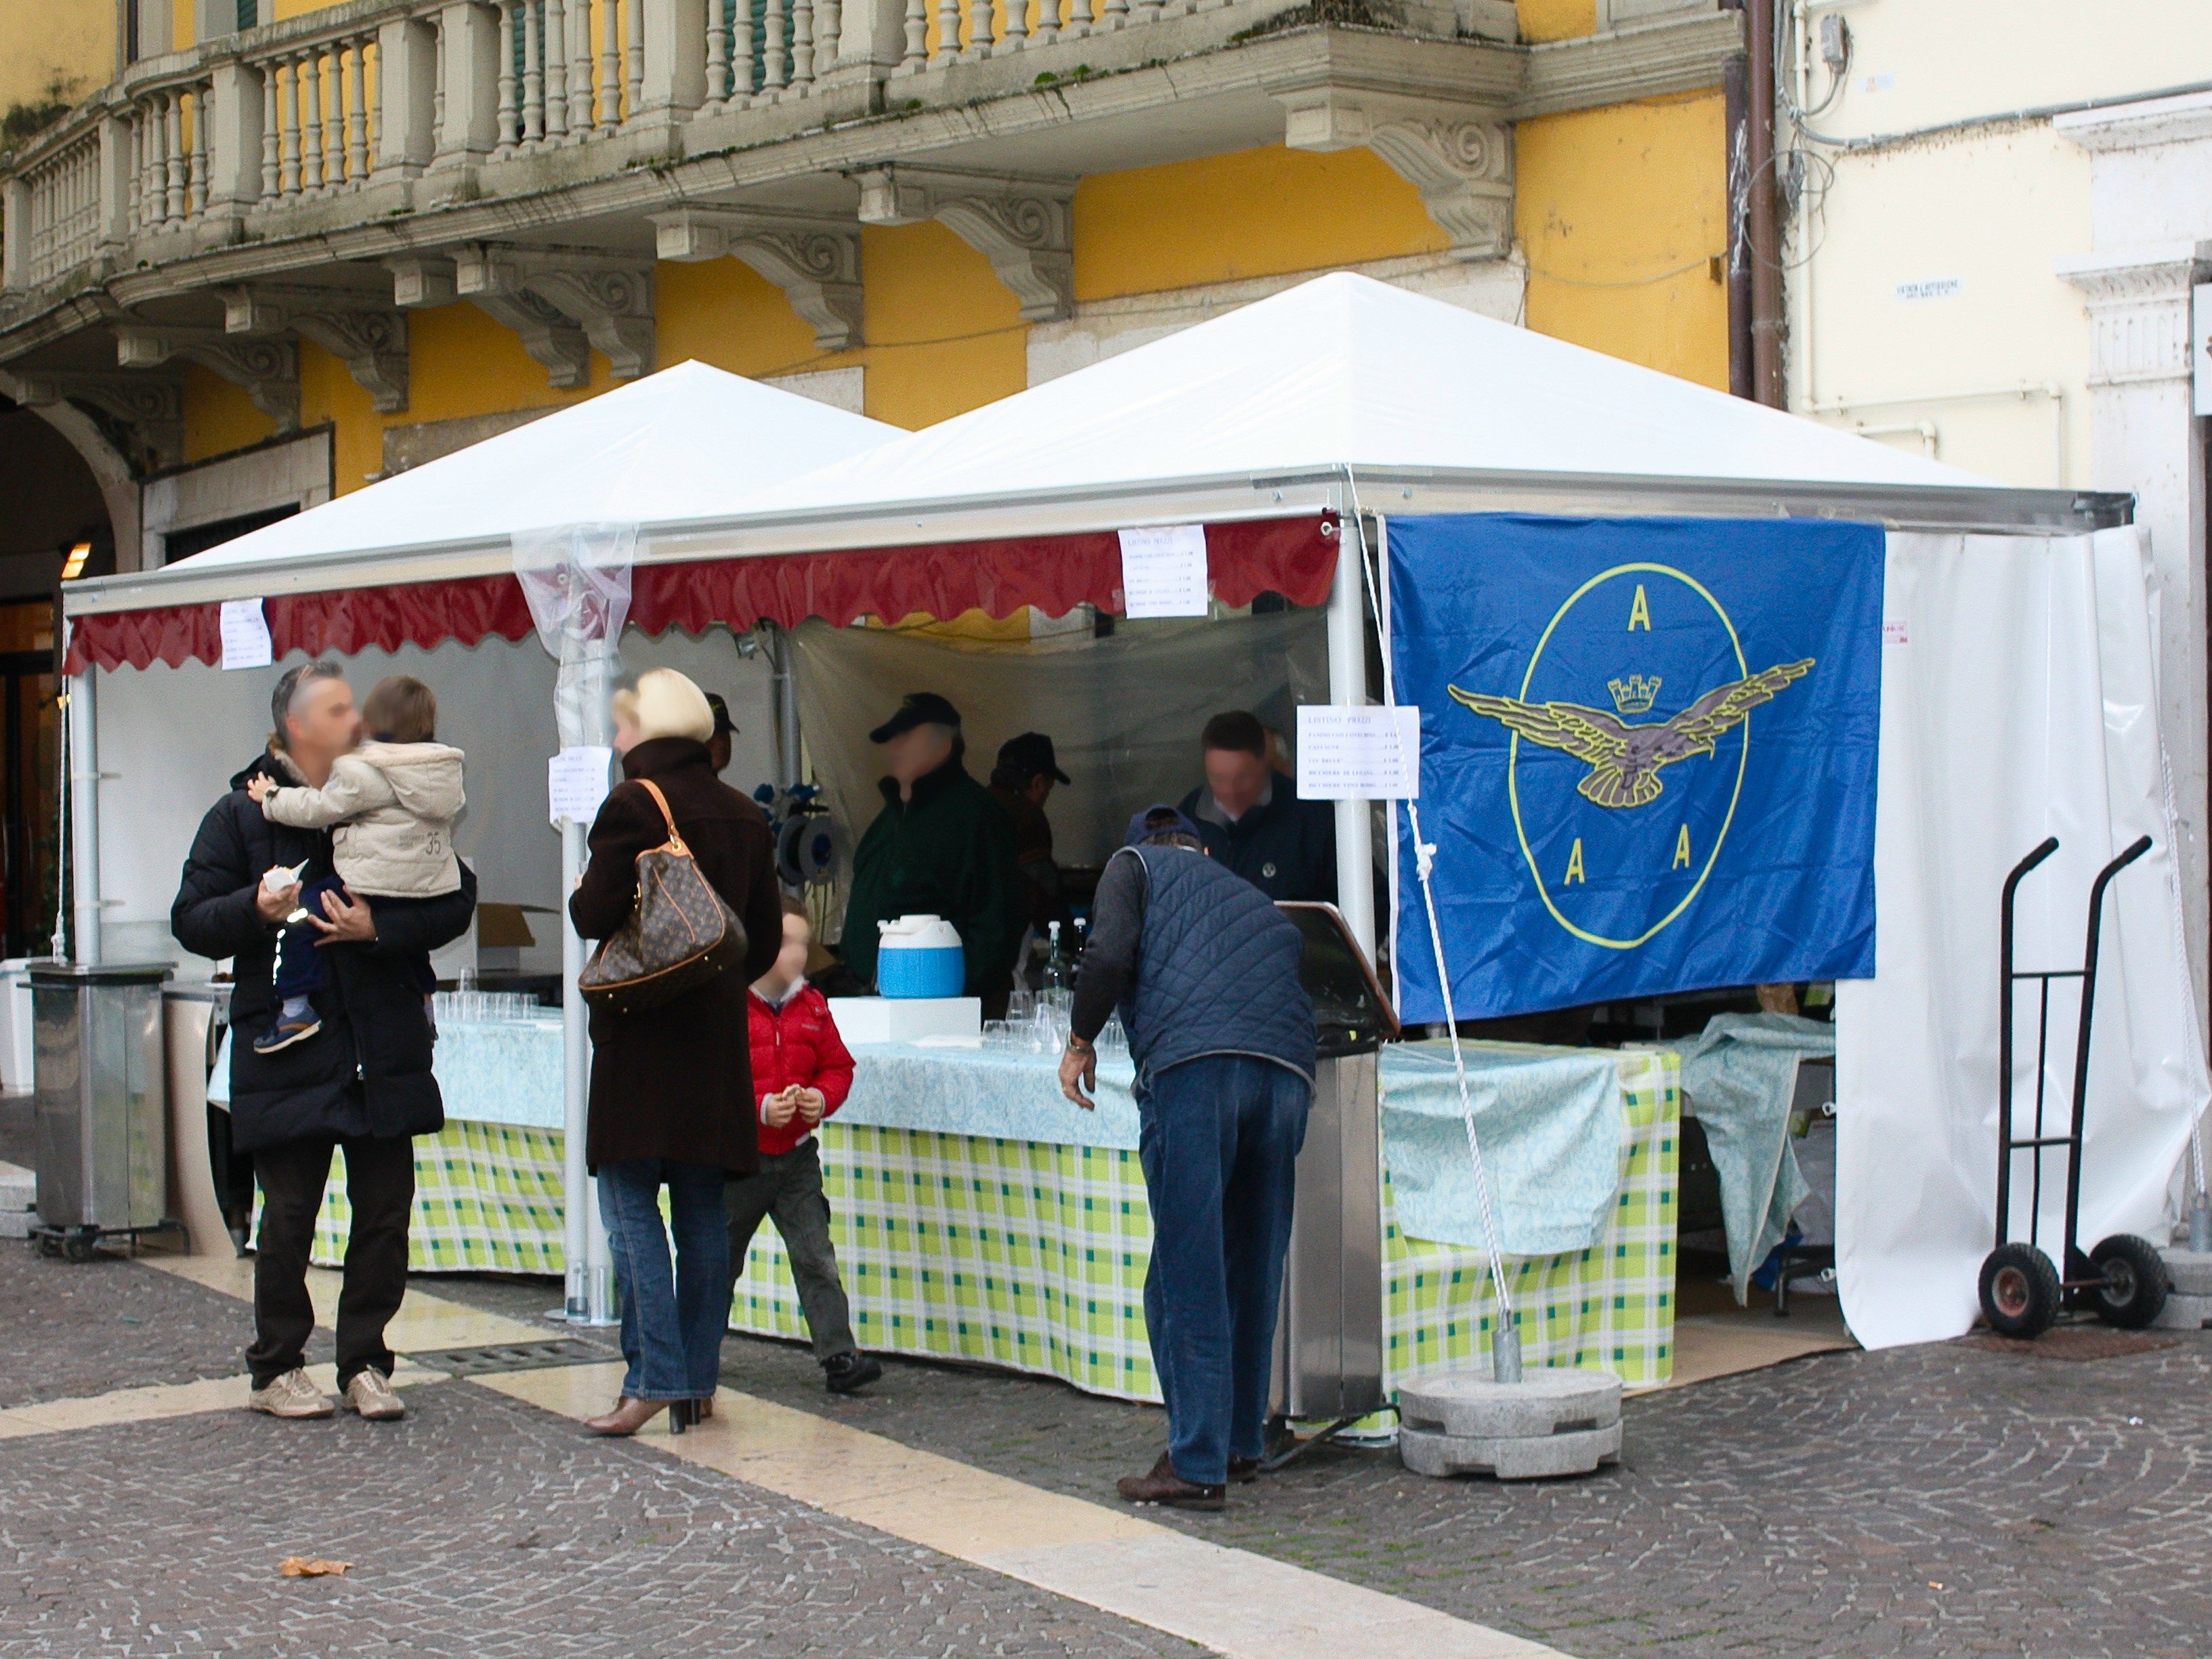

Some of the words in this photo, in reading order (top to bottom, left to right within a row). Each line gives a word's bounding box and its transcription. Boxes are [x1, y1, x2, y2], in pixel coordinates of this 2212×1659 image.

[1628, 584, 1651, 632] A
[425, 831, 442, 855] 35
[1564, 838, 1585, 886] A
[1672, 823, 1690, 870] A
